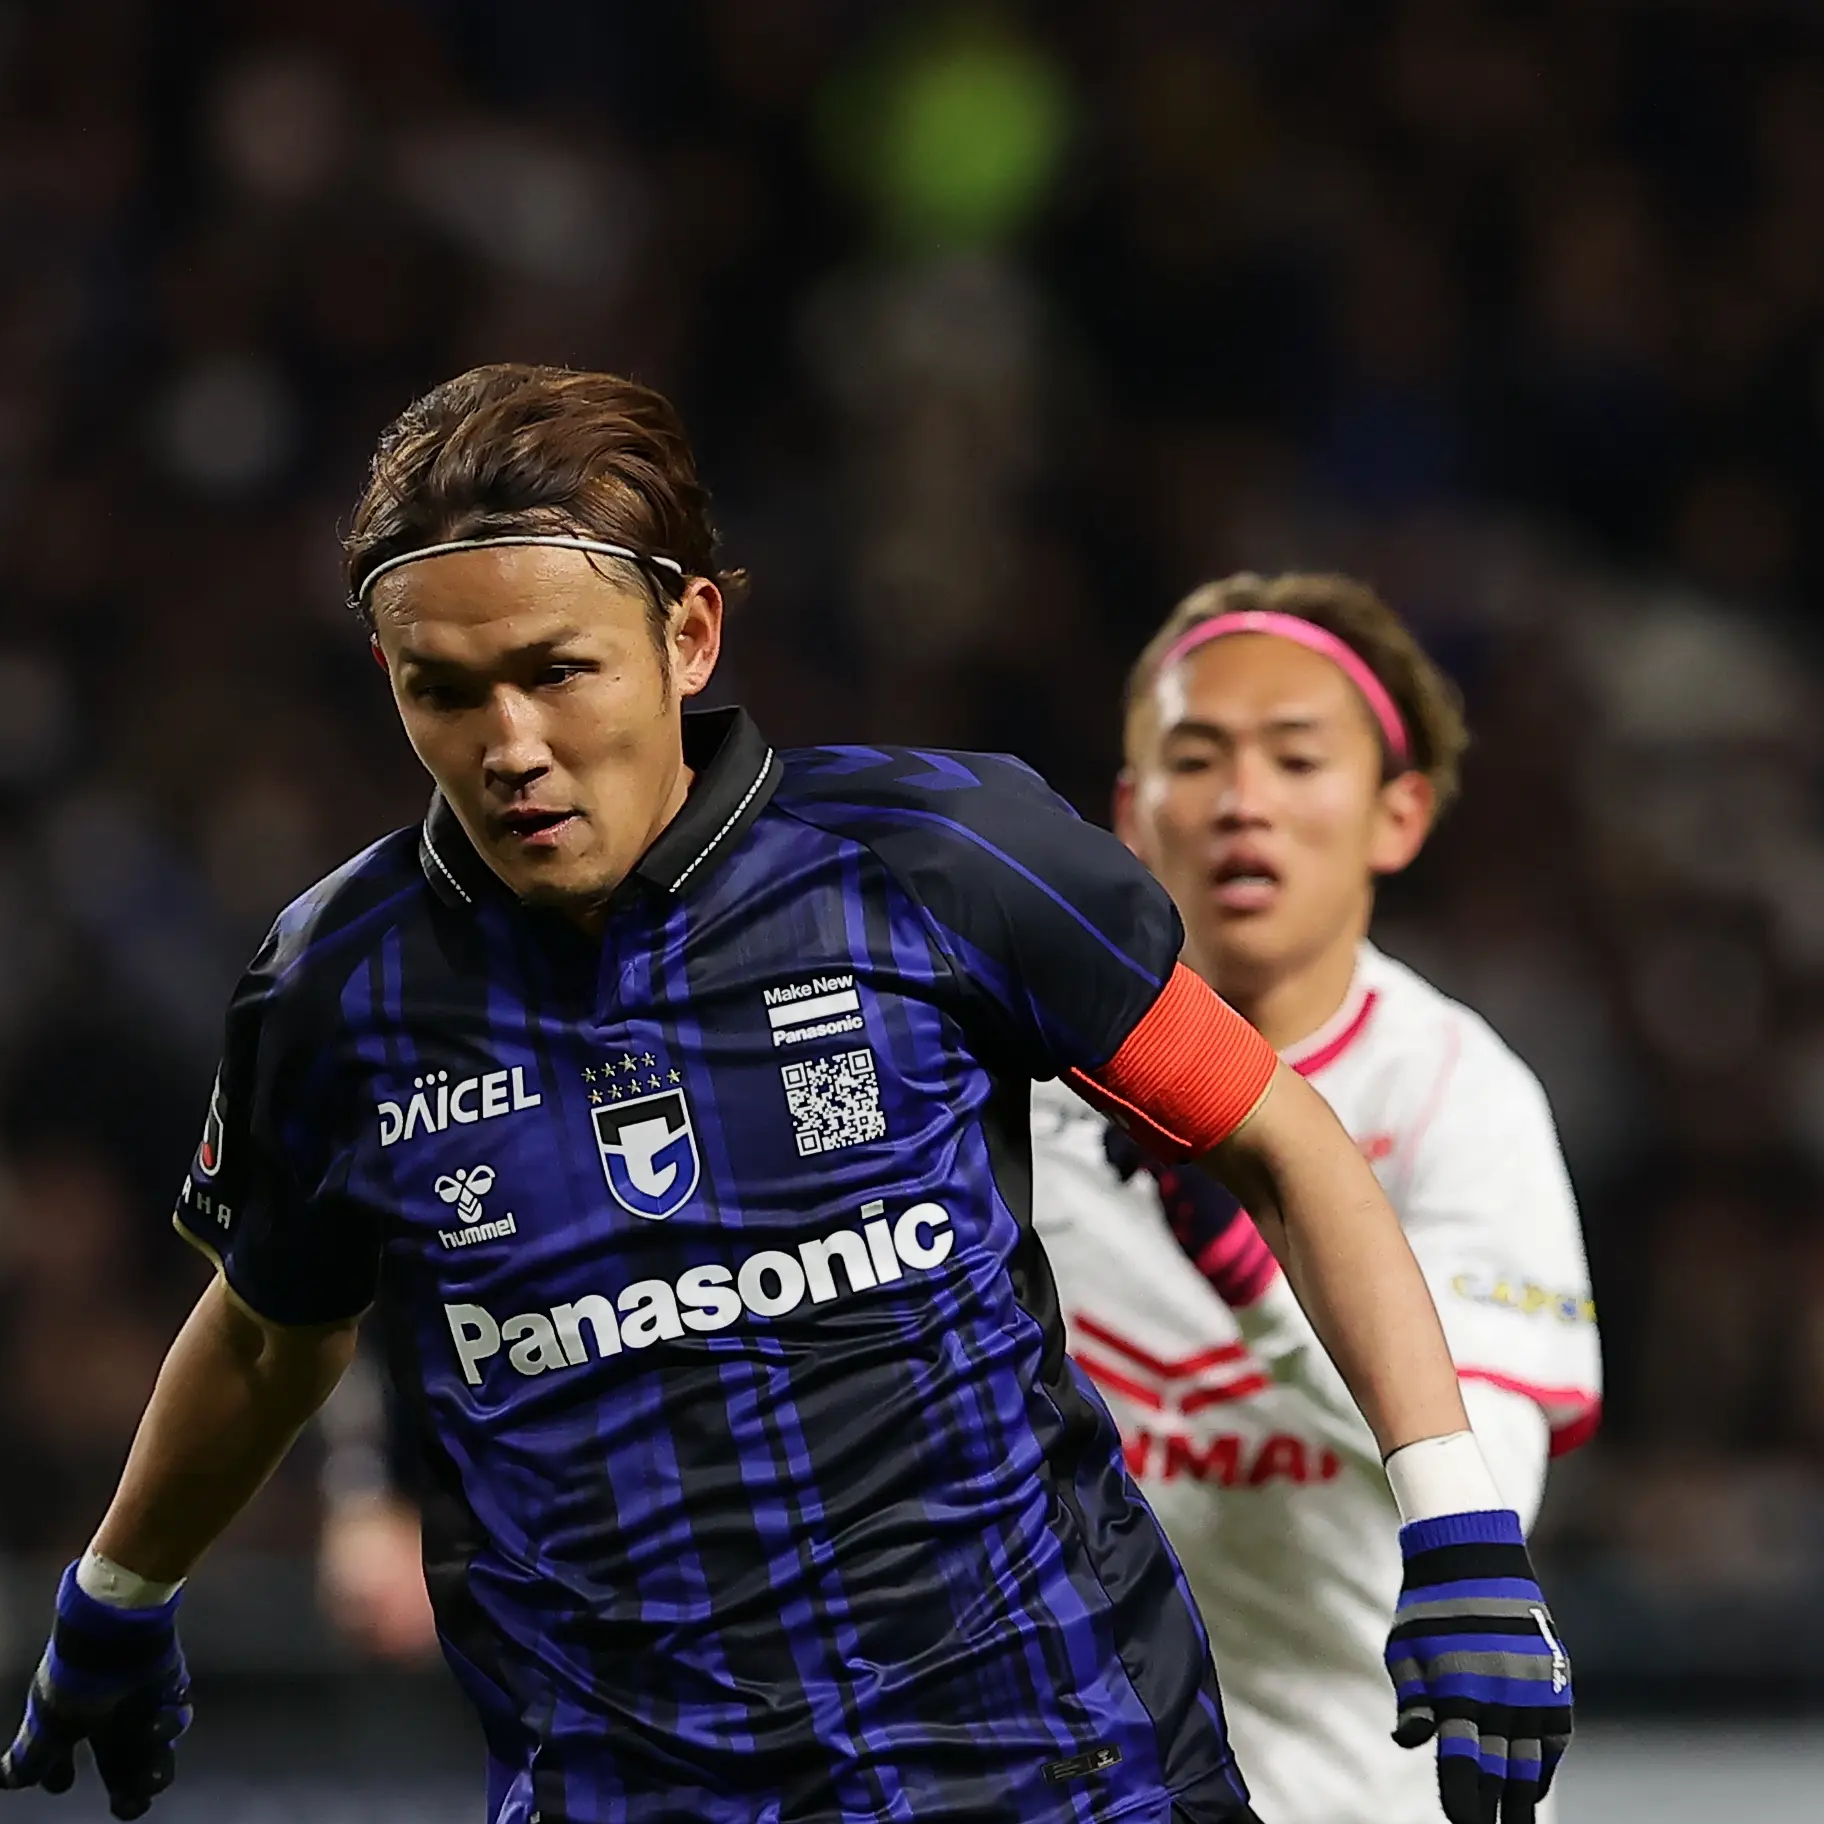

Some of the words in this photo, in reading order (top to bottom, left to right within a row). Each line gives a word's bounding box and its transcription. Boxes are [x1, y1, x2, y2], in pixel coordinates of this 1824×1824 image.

[763, 983, 812, 1006] Make
[812, 975, 853, 994] New
[773, 1015, 864, 1047] Panasonic
[438, 1212, 517, 1250] hummel
[444, 1199, 954, 1386] Panasonic
